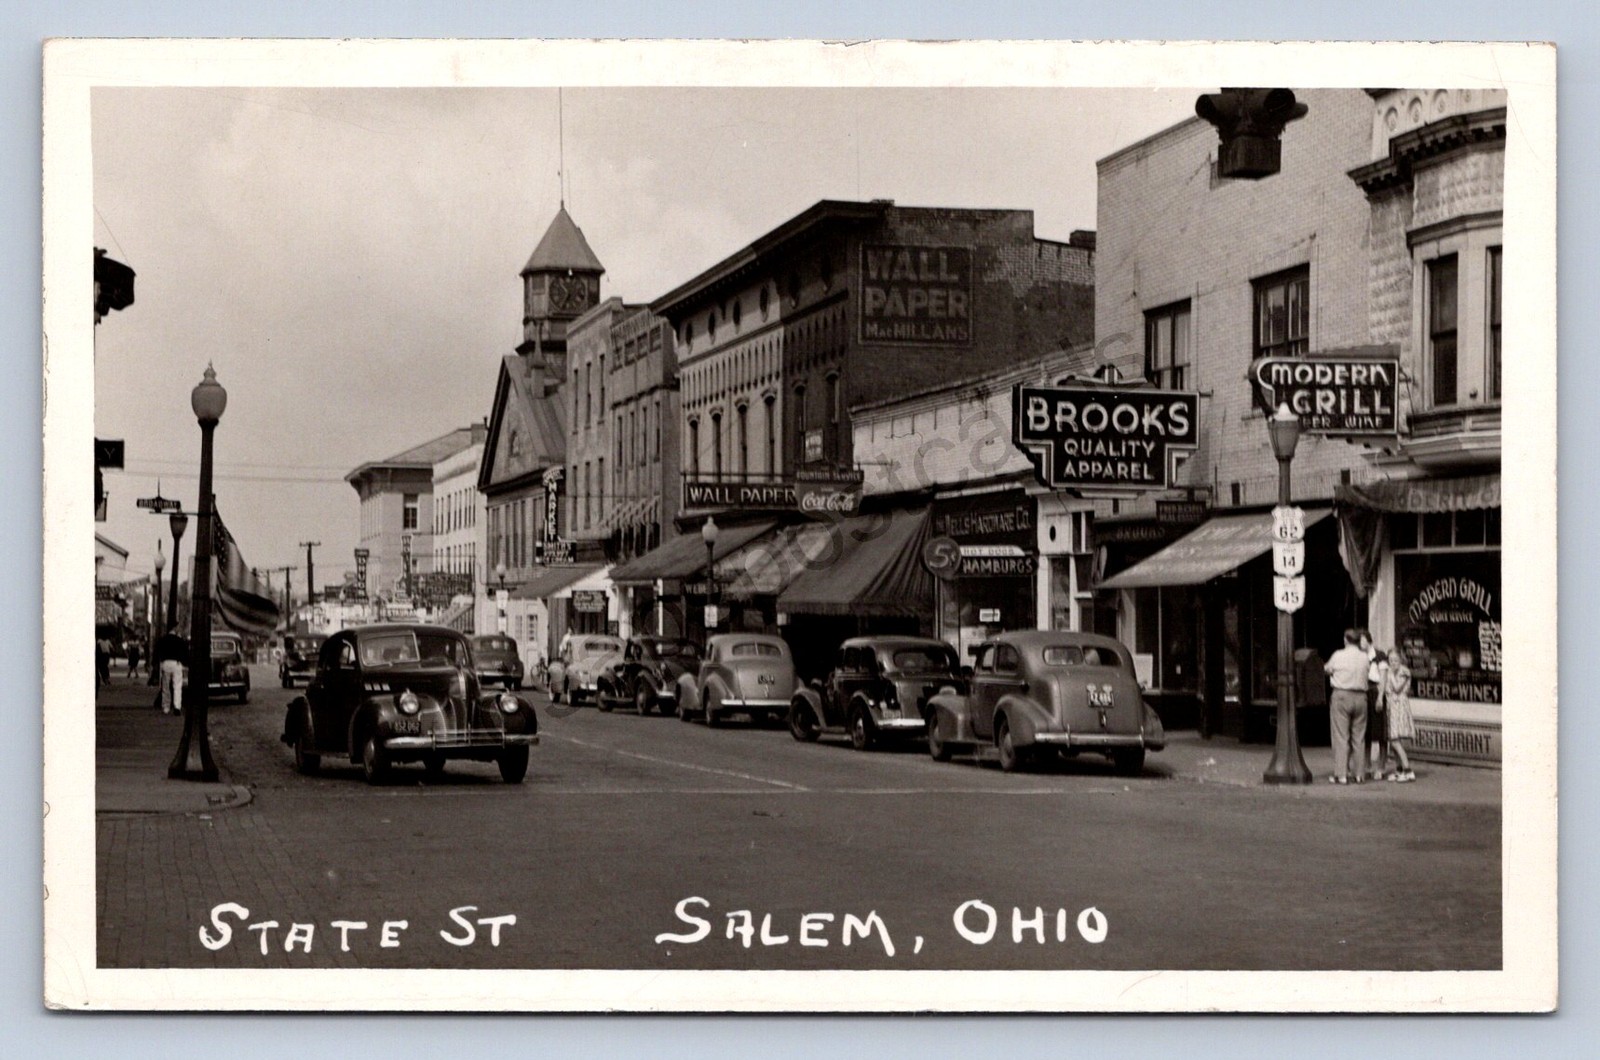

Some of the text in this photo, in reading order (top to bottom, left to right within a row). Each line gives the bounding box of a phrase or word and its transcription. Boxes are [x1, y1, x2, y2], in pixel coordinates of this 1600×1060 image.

[866, 250, 959, 280] WALL
[864, 286, 969, 318] PAPER
[1271, 363, 1390, 386] MODERN
[1293, 388, 1391, 415] GRILL
[1026, 396, 1190, 438] BROOKS
[1345, 416, 1384, 429] WINE
[1063, 439, 1156, 457] QUALITY
[1063, 462, 1155, 480] APPAREL
[689, 486, 796, 504] WALL PAPER
[1279, 526, 1299, 539] 62
[962, 558, 1034, 574] HAMBURGS
[1283, 556, 1296, 568] 14
[1281, 591, 1300, 604] 45
[1408, 576, 1492, 624] MODERN GRILL
[1418, 680, 1450, 700] BEER
[199, 902, 408, 954] STATE
[440, 905, 516, 946] ST
[953, 899, 1108, 944] OHIO
